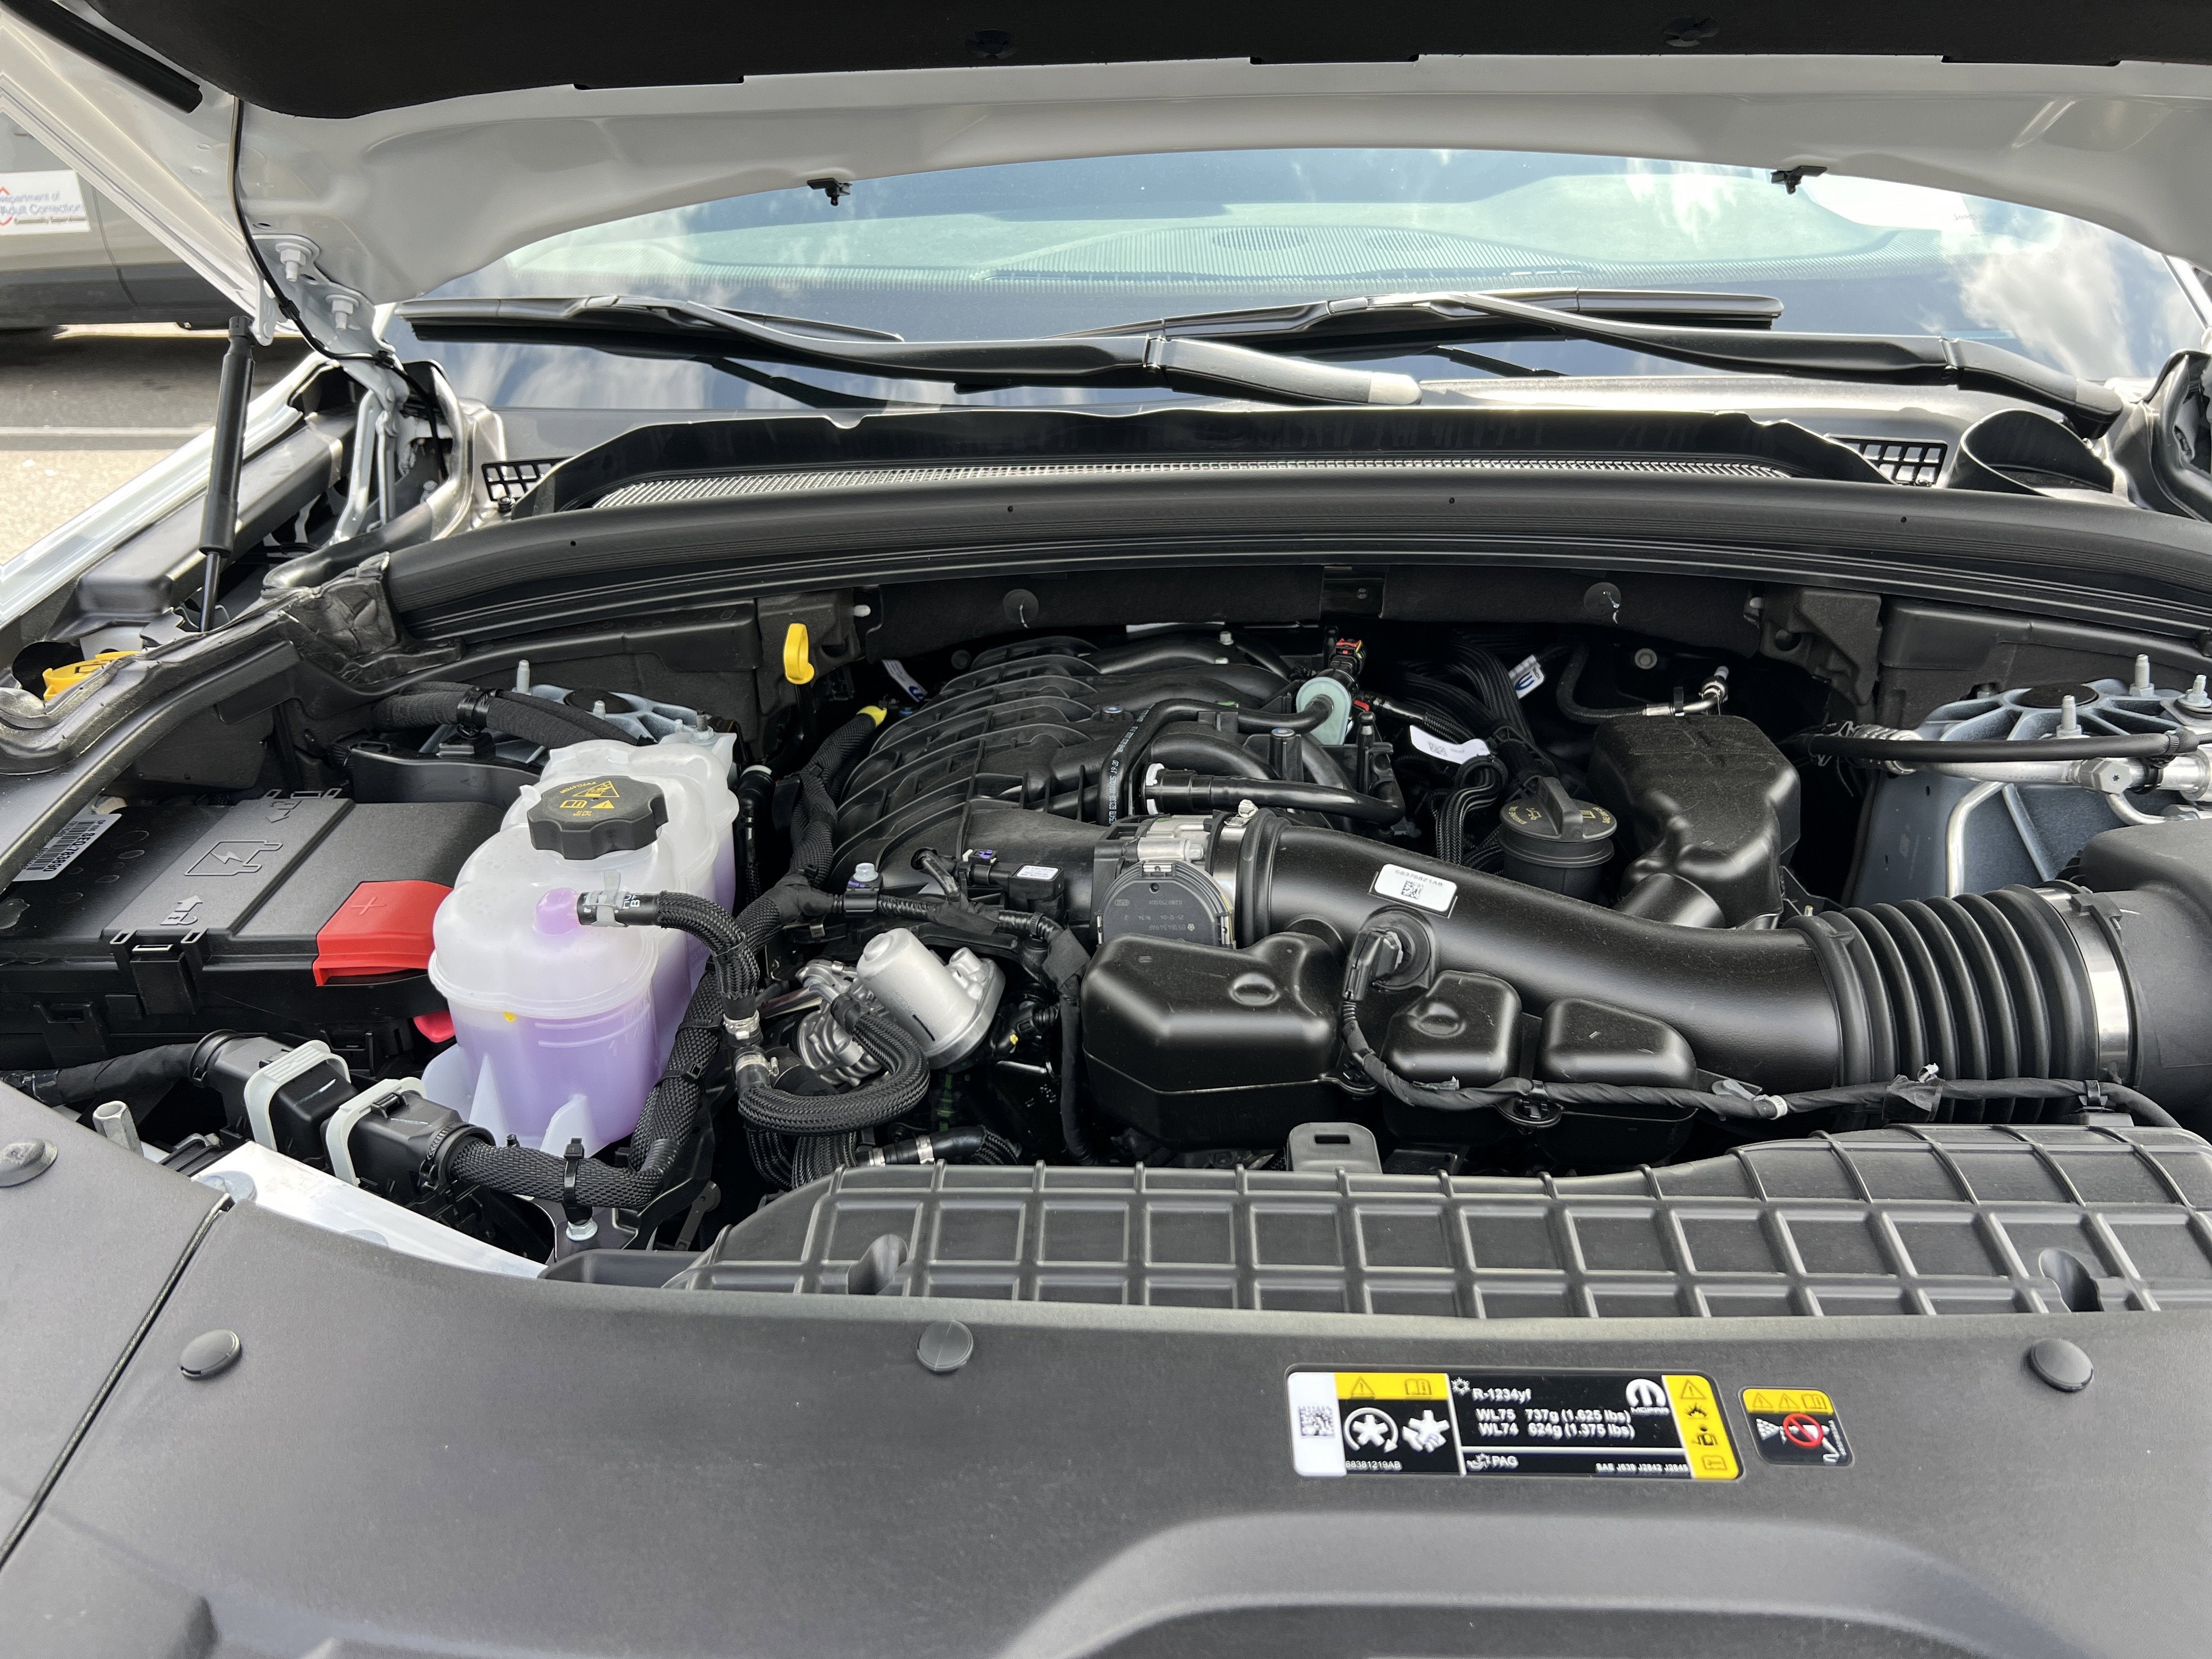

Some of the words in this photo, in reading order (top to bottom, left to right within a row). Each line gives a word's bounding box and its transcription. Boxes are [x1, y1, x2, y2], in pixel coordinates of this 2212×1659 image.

[1472, 1388, 1531, 1404] R-1234yf
[1476, 1408, 1516, 1422] WL75
[1525, 1408, 1559, 1424] 737g
[1561, 1409, 1602, 1423] (1.625
[1604, 1409, 1631, 1424] lbs)
[1479, 1422, 1519, 1436] WL74
[1528, 1423, 1562, 1440] 624g
[1564, 1423, 1606, 1439] (1.375
[1607, 1423, 1635, 1440] lbs)
[1492, 1455, 1519, 1469] PAG
[1595, 1463, 1615, 1472] SAE
